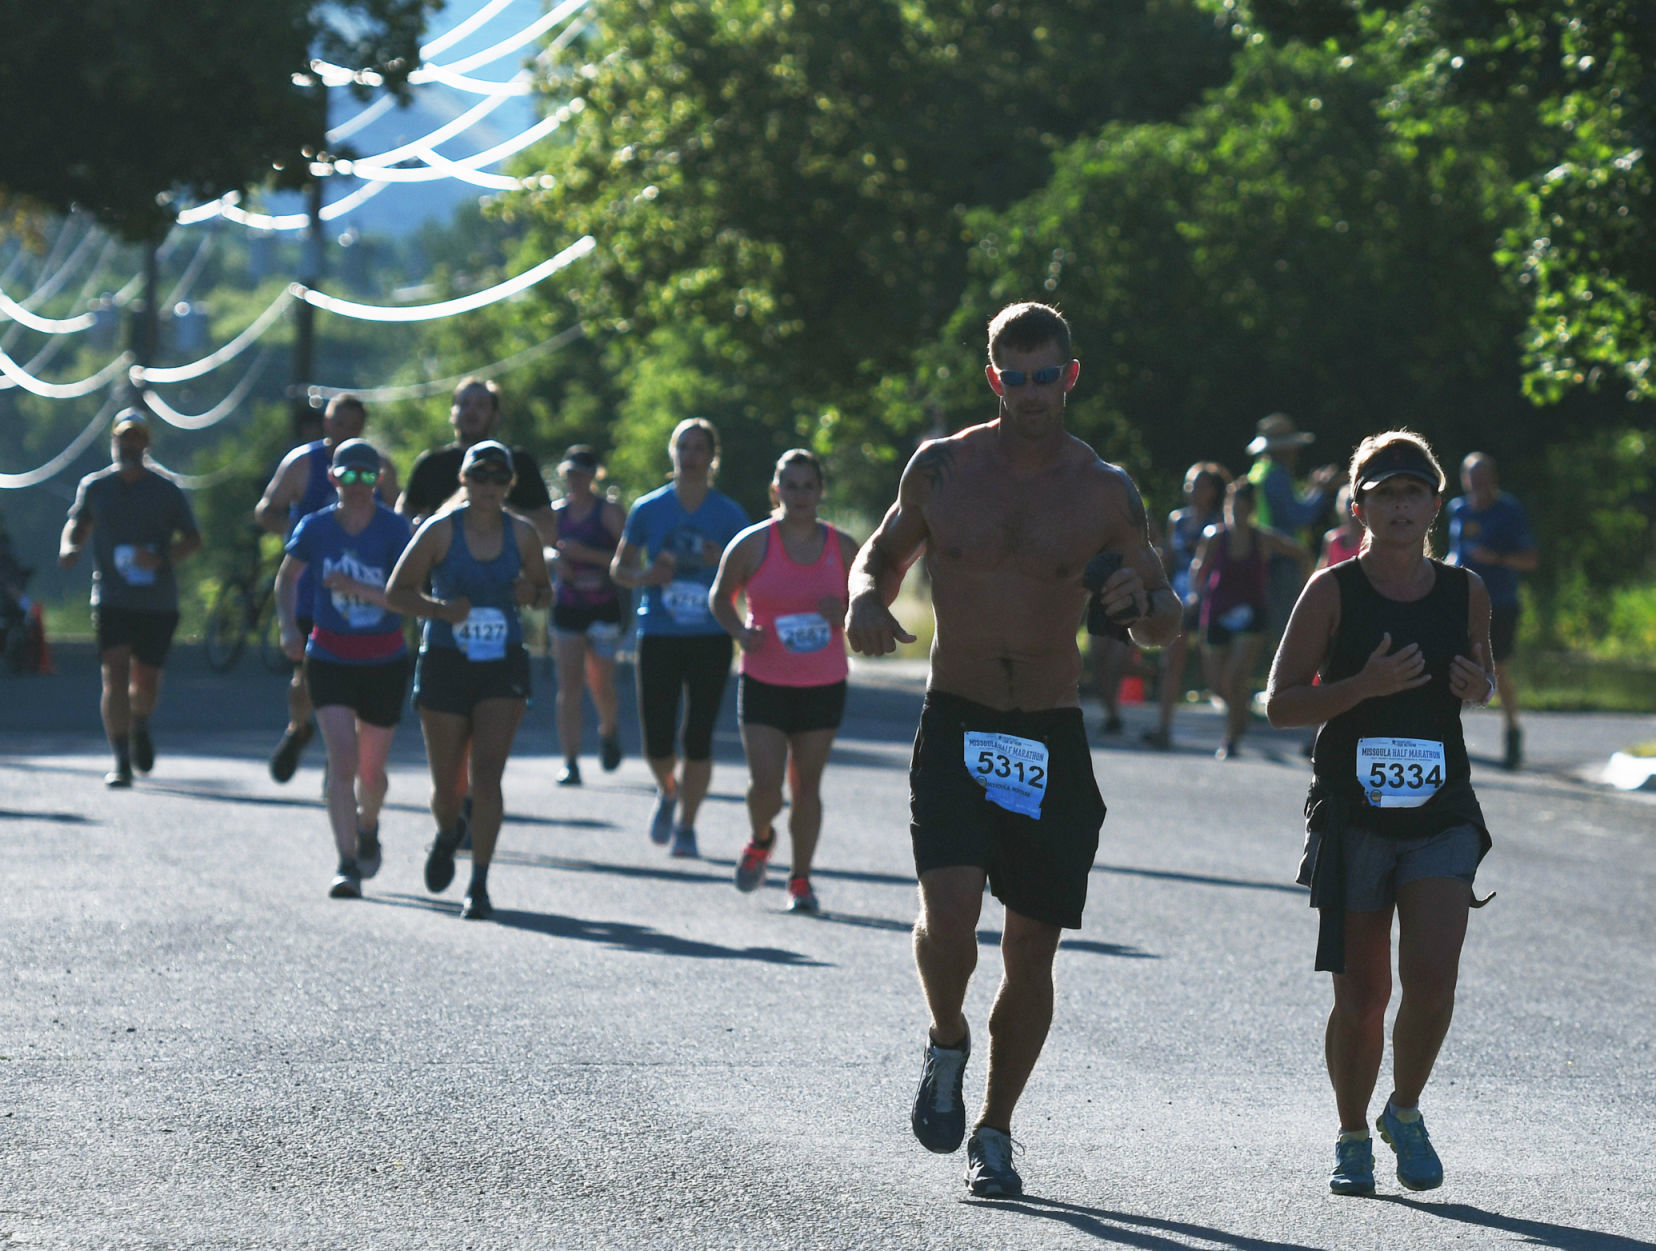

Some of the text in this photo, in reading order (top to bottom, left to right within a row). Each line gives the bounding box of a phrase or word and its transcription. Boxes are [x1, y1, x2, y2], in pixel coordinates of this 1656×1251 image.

[457, 623, 503, 641] 4127
[969, 739, 997, 749] MISSOULA
[1013, 748, 1044, 761] MARATHON
[1361, 747, 1391, 757] MISSOULA
[1392, 748, 1407, 757] HALF
[1408, 749, 1441, 759] MARATHON
[977, 751, 1045, 789] 5312
[1369, 762, 1443, 789] 5334
